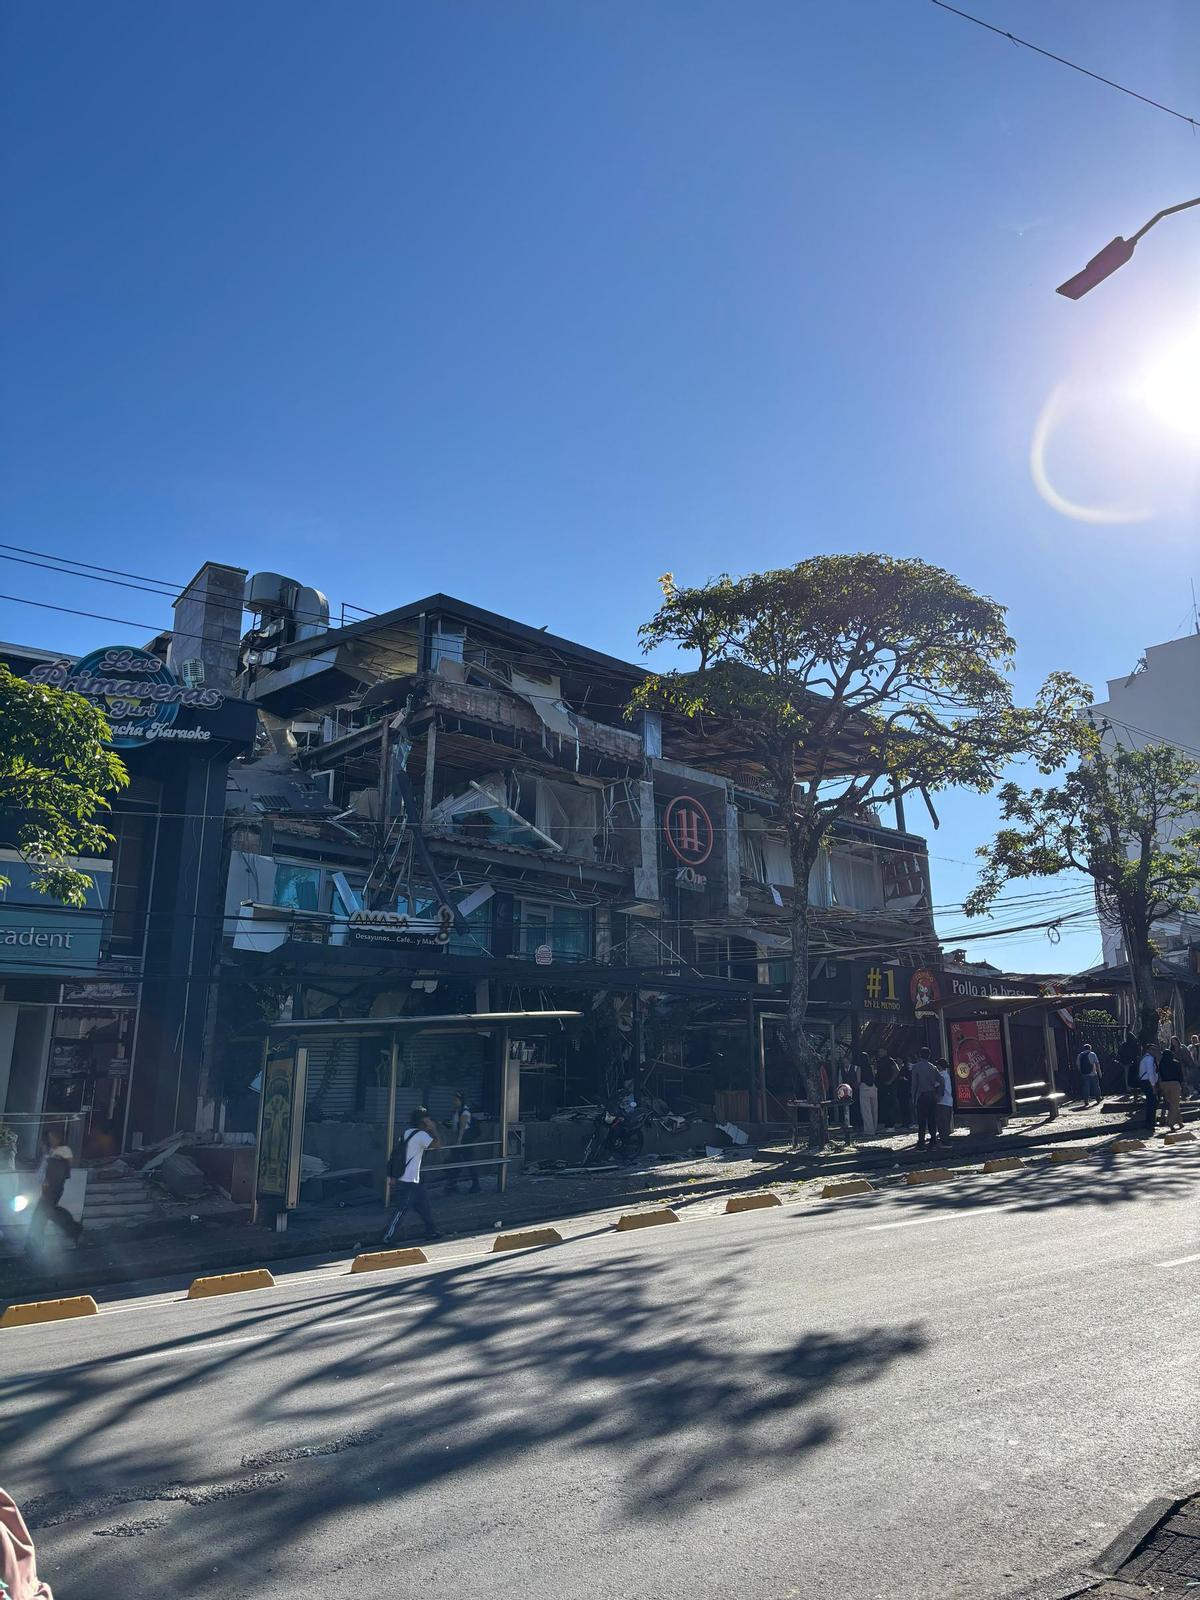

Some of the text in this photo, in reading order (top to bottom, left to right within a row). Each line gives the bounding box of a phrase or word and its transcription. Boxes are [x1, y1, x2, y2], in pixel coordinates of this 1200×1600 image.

[98, 649, 162, 673] Las
[22, 659, 225, 710] Primaveras
[109, 700, 157, 719] Yuri
[145, 721, 212, 743] Karaoke
[866, 967, 900, 1000] #1
[952, 979, 979, 997] Pollo
[980, 985, 988, 998] a
[989, 983, 999, 996] la
[881, 1000, 901, 1011] MUNDO
